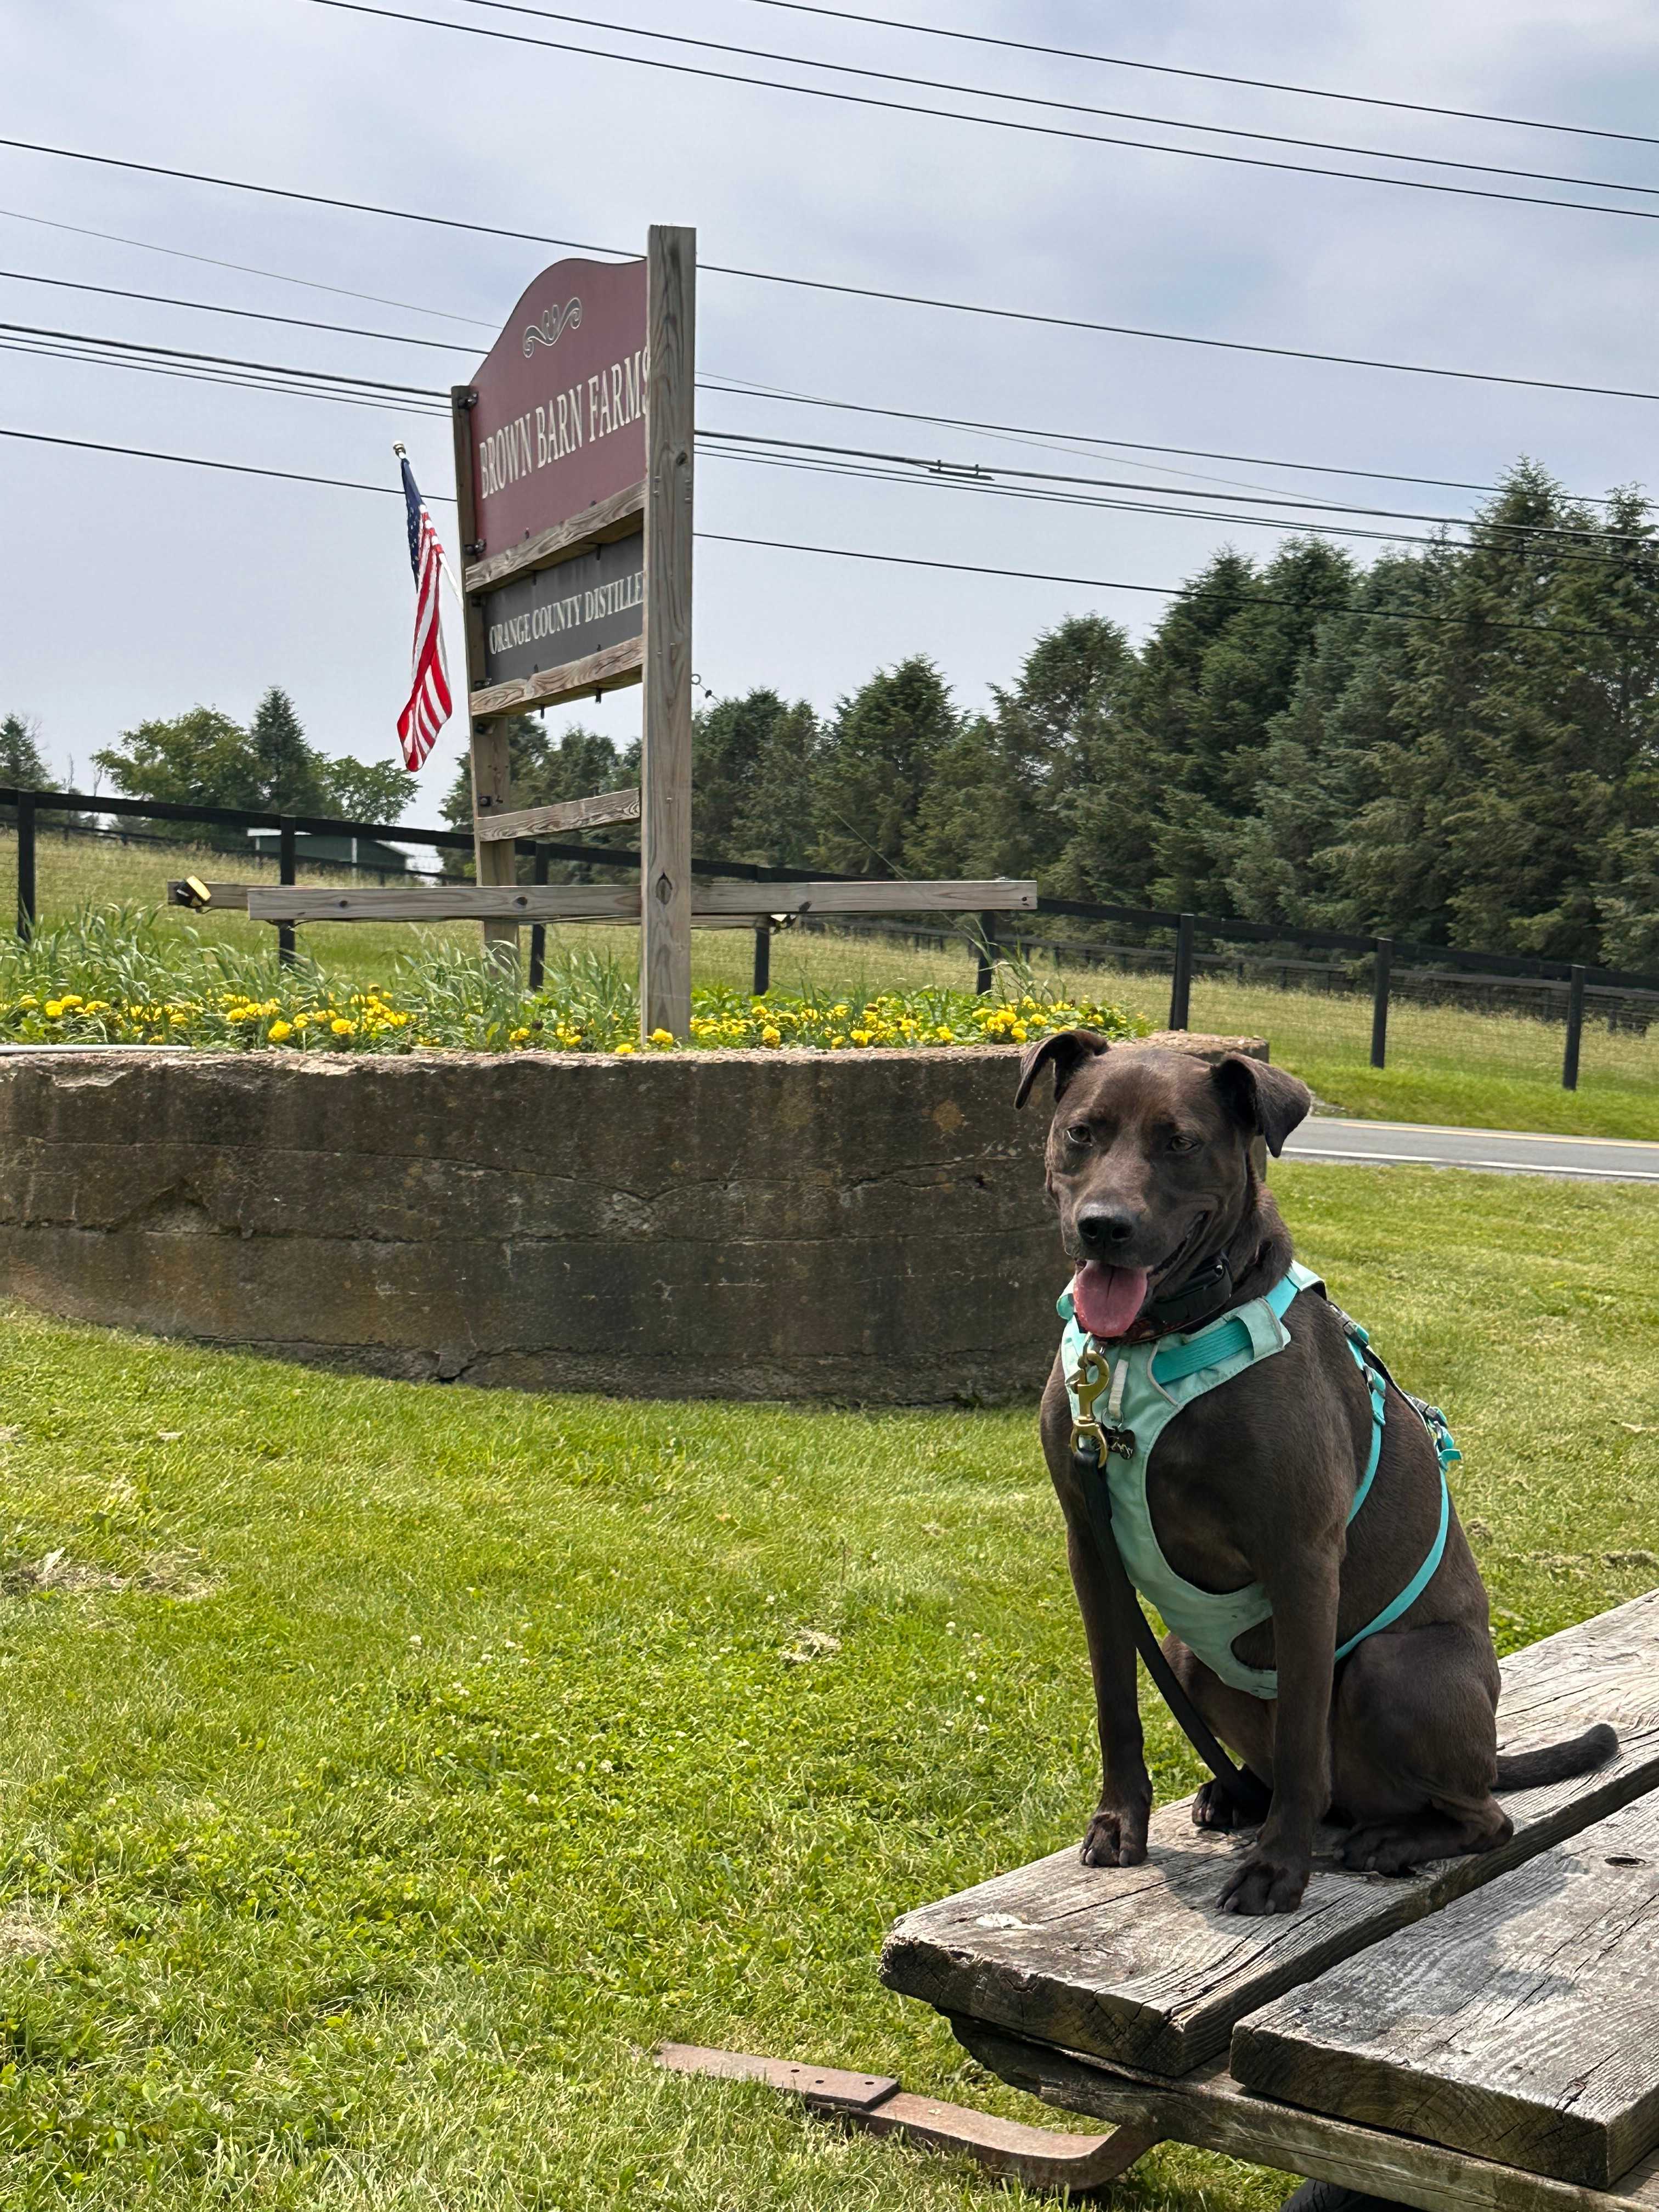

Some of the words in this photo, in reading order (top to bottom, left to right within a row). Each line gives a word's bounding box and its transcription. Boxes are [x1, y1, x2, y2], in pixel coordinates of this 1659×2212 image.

[479, 413, 532, 499] BROWN
[535, 384, 582, 468] BARN
[489, 613, 531, 654] ORANGE
[532, 594, 582, 639] COUNTY
